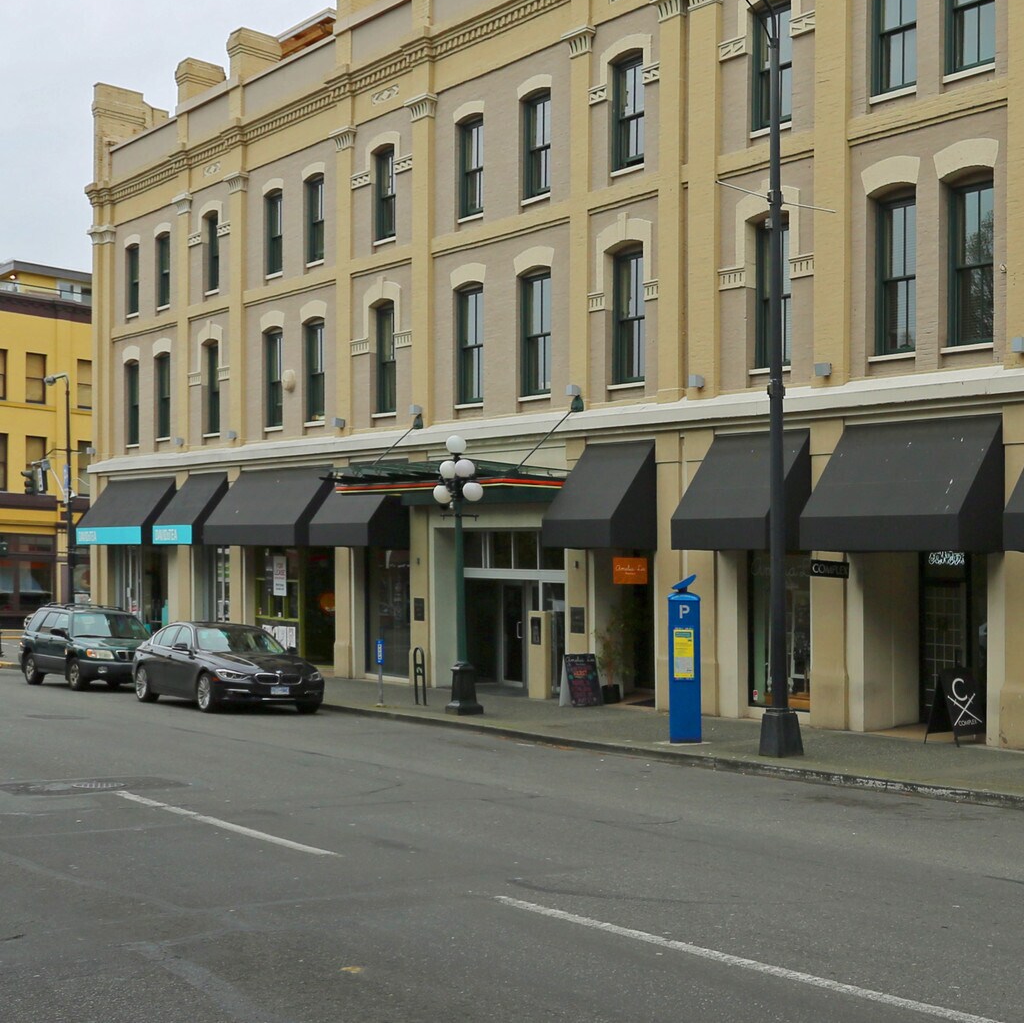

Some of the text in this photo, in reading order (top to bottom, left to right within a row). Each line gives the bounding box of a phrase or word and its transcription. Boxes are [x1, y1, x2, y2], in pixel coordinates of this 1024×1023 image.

[812, 563, 848, 576] COMPLEX
[679, 604, 690, 619] P
[958, 719, 978, 727] COMPLEX
